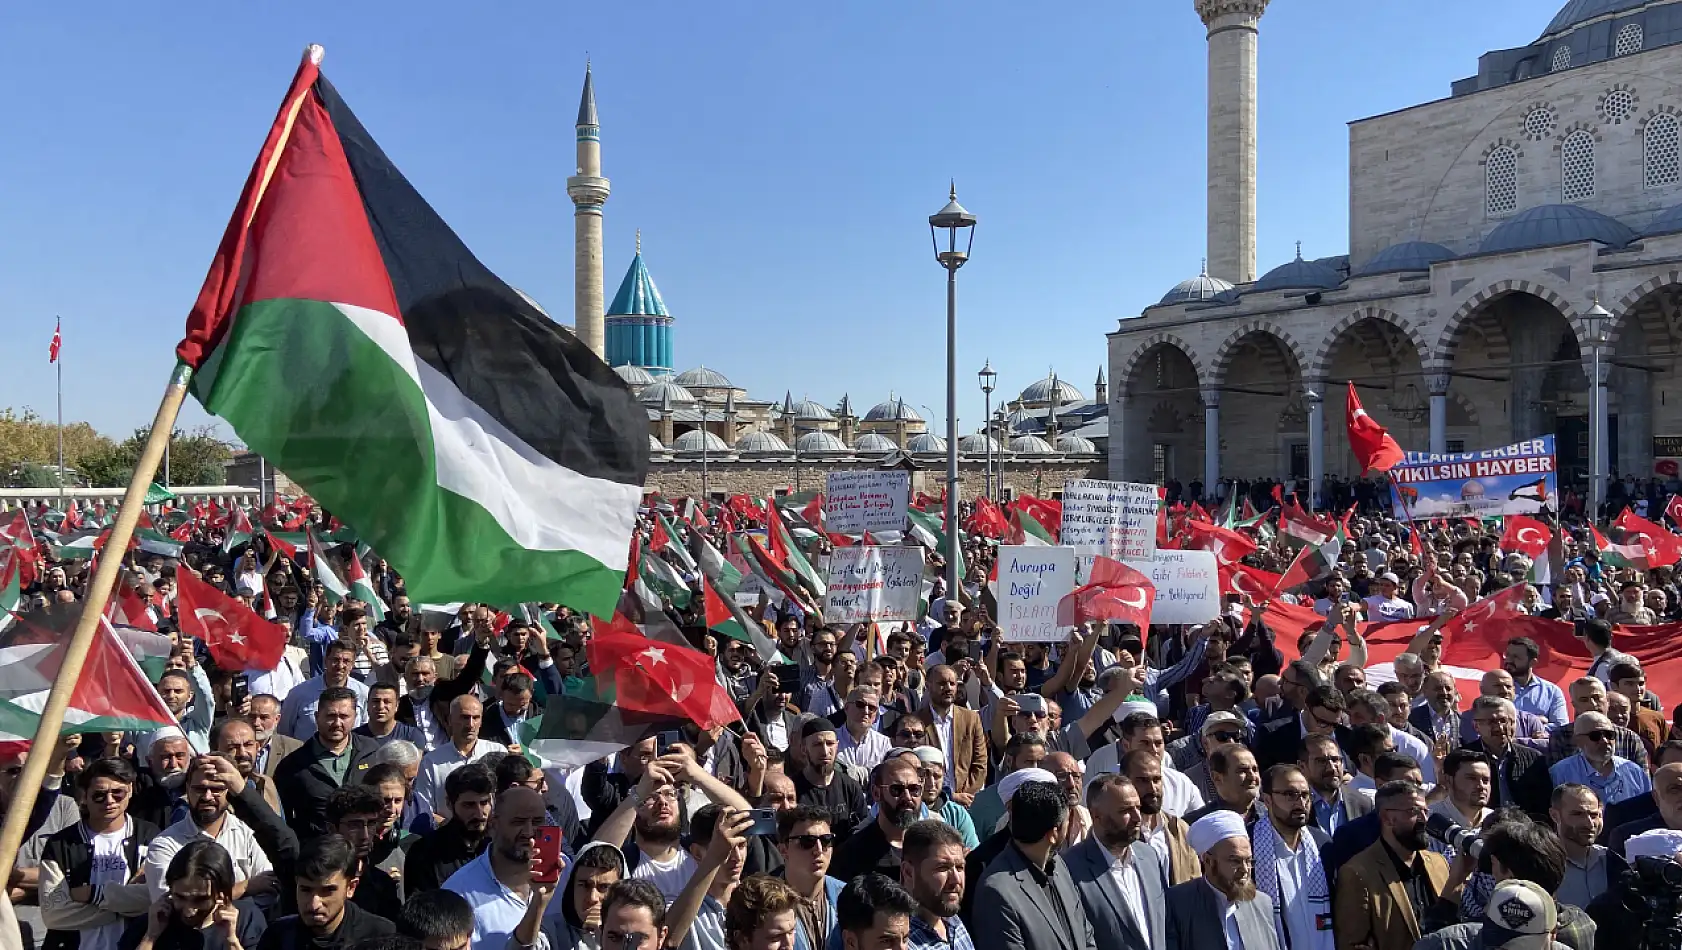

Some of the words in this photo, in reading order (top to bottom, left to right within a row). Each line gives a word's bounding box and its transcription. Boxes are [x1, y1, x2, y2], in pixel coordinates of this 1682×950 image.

[1393, 463, 1471, 483] YIKILSIN
[1476, 457, 1551, 477] HAYBER
[1010, 581, 1042, 600] Değil
[1010, 602, 1056, 620] İSLAM
